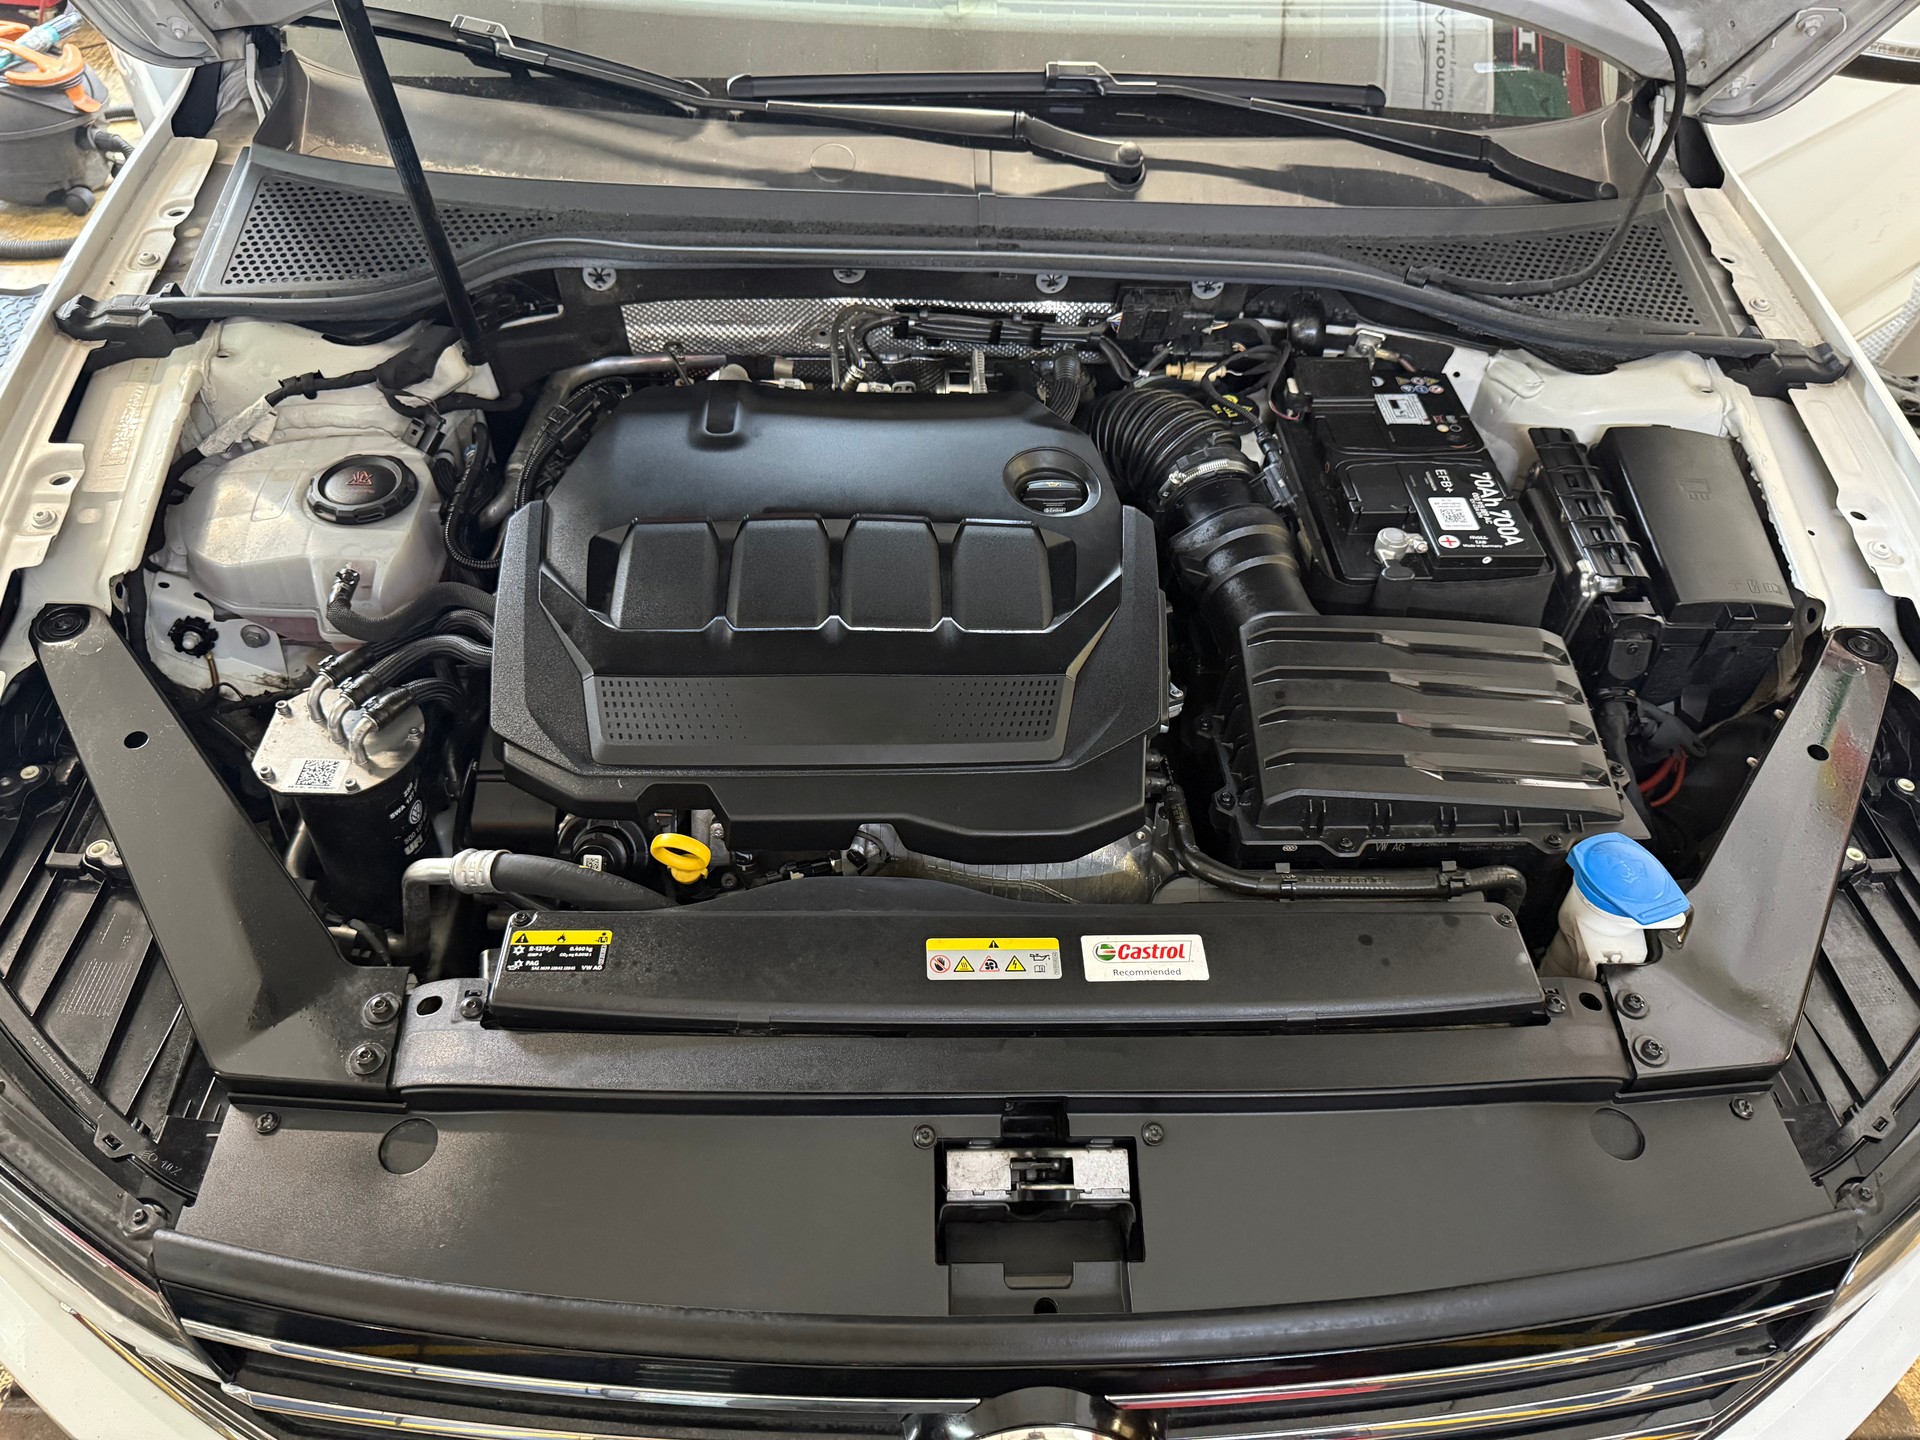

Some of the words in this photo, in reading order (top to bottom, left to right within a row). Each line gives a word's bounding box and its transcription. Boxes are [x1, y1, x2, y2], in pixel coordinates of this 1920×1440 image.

[1434, 468, 1454, 494] EFB+
[1470, 471, 1503, 507] 70Ah
[1489, 509, 1525, 546] 700A
[528, 945, 557, 953] R-1234yf
[1117, 942, 1186, 961] Castrol
[1113, 967, 1182, 977] Recommended
